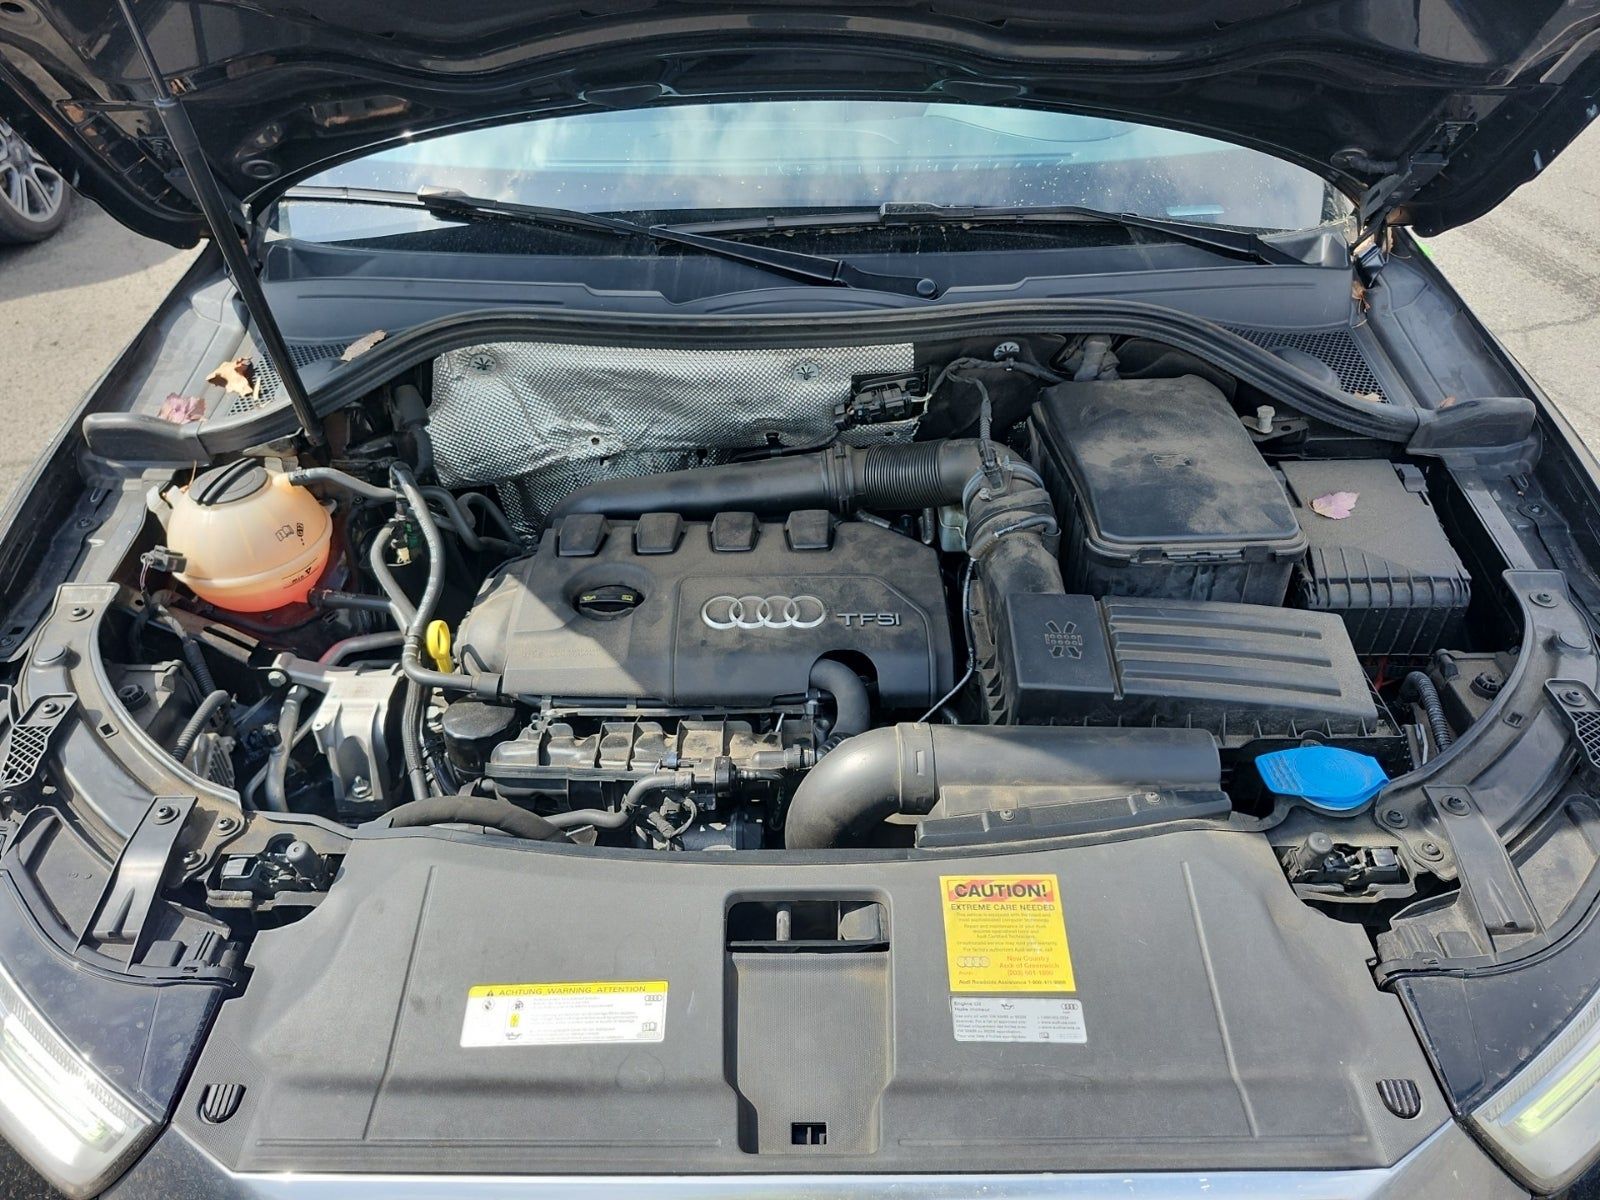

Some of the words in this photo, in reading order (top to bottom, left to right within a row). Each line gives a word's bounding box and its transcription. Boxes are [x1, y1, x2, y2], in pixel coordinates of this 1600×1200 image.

[836, 612, 900, 626] TFSI
[954, 884, 1047, 897] CAUTION!
[499, 988, 542, 996] ACHTUNG
[546, 986, 592, 994] WARNING
[597, 985, 646, 993] ATTENTION
